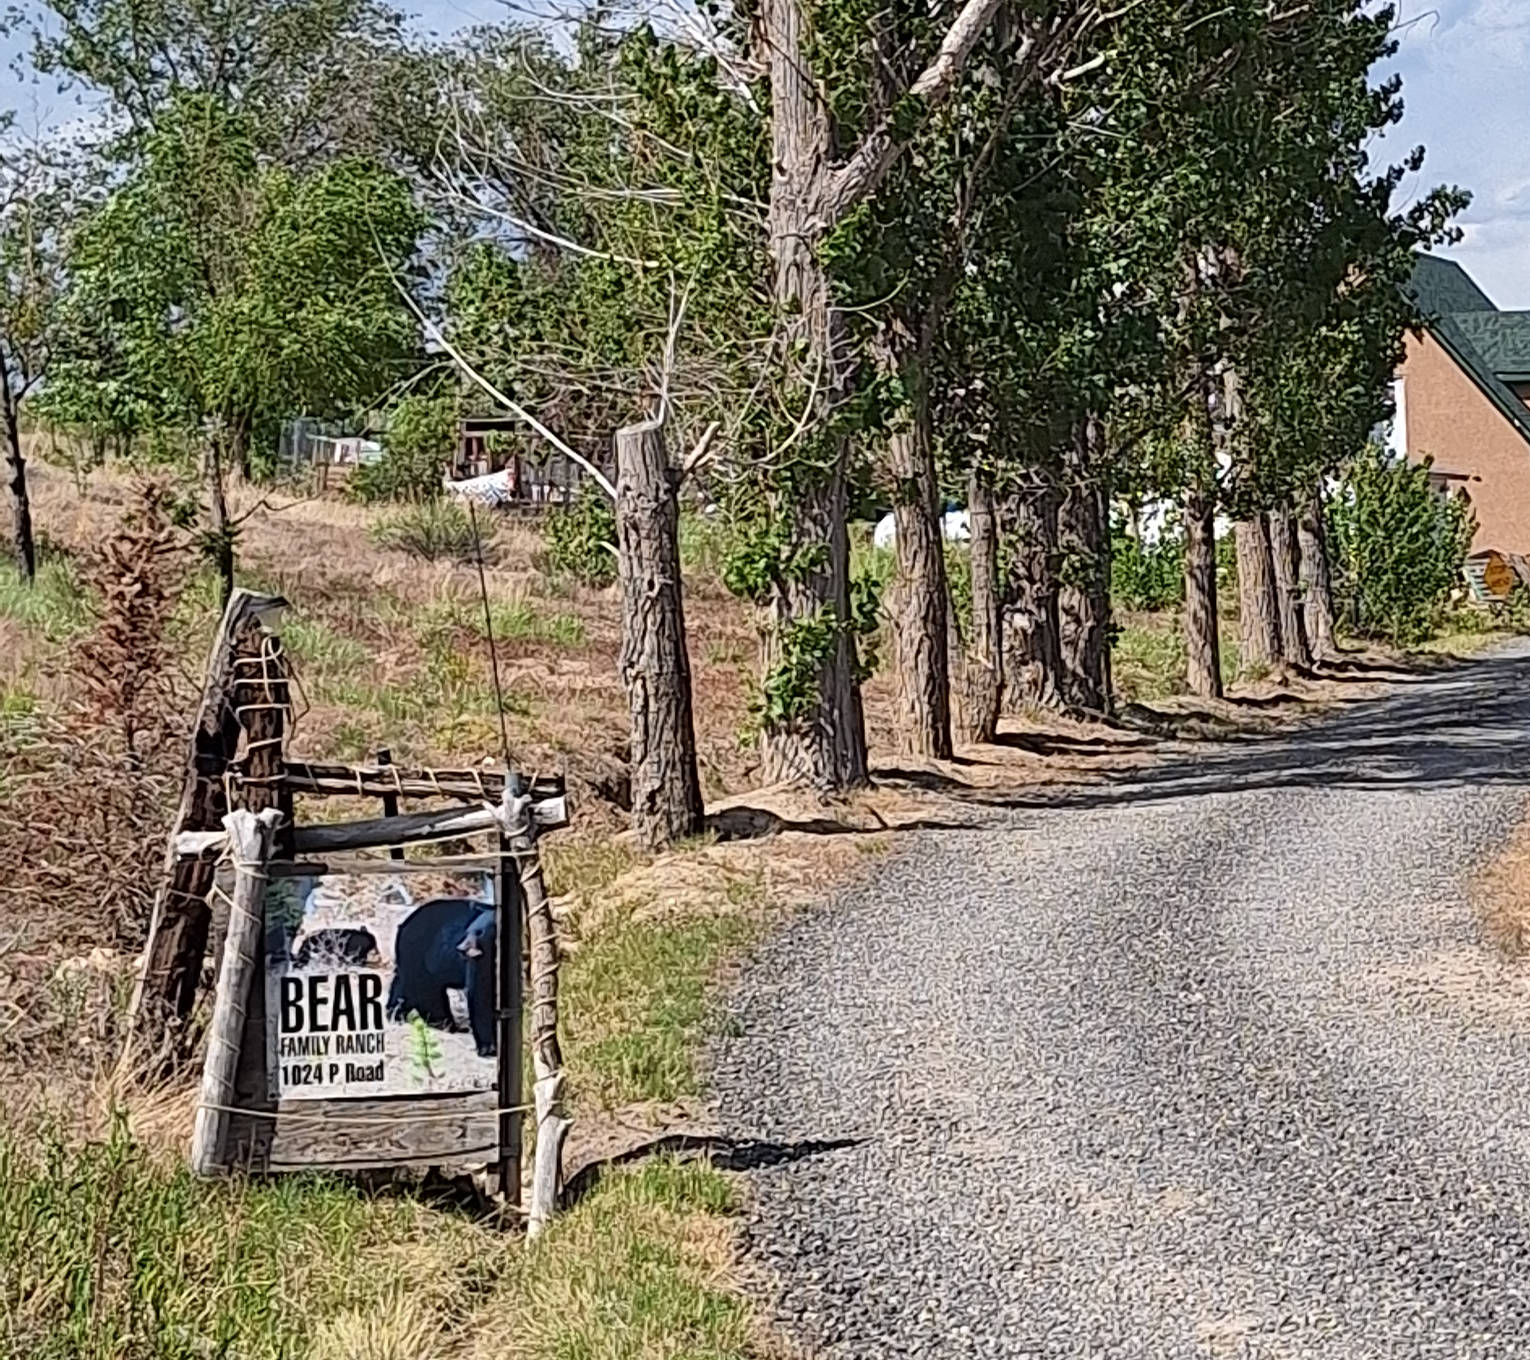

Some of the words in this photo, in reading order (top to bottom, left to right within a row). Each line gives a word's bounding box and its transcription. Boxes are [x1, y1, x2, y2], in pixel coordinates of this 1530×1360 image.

[280, 974, 384, 1033] BEAR
[281, 1036, 330, 1057] FAMILY
[336, 1033, 385, 1054] RANCH
[282, 1063, 323, 1085] 1024
[329, 1063, 340, 1083] P
[346, 1059, 384, 1083] Road
